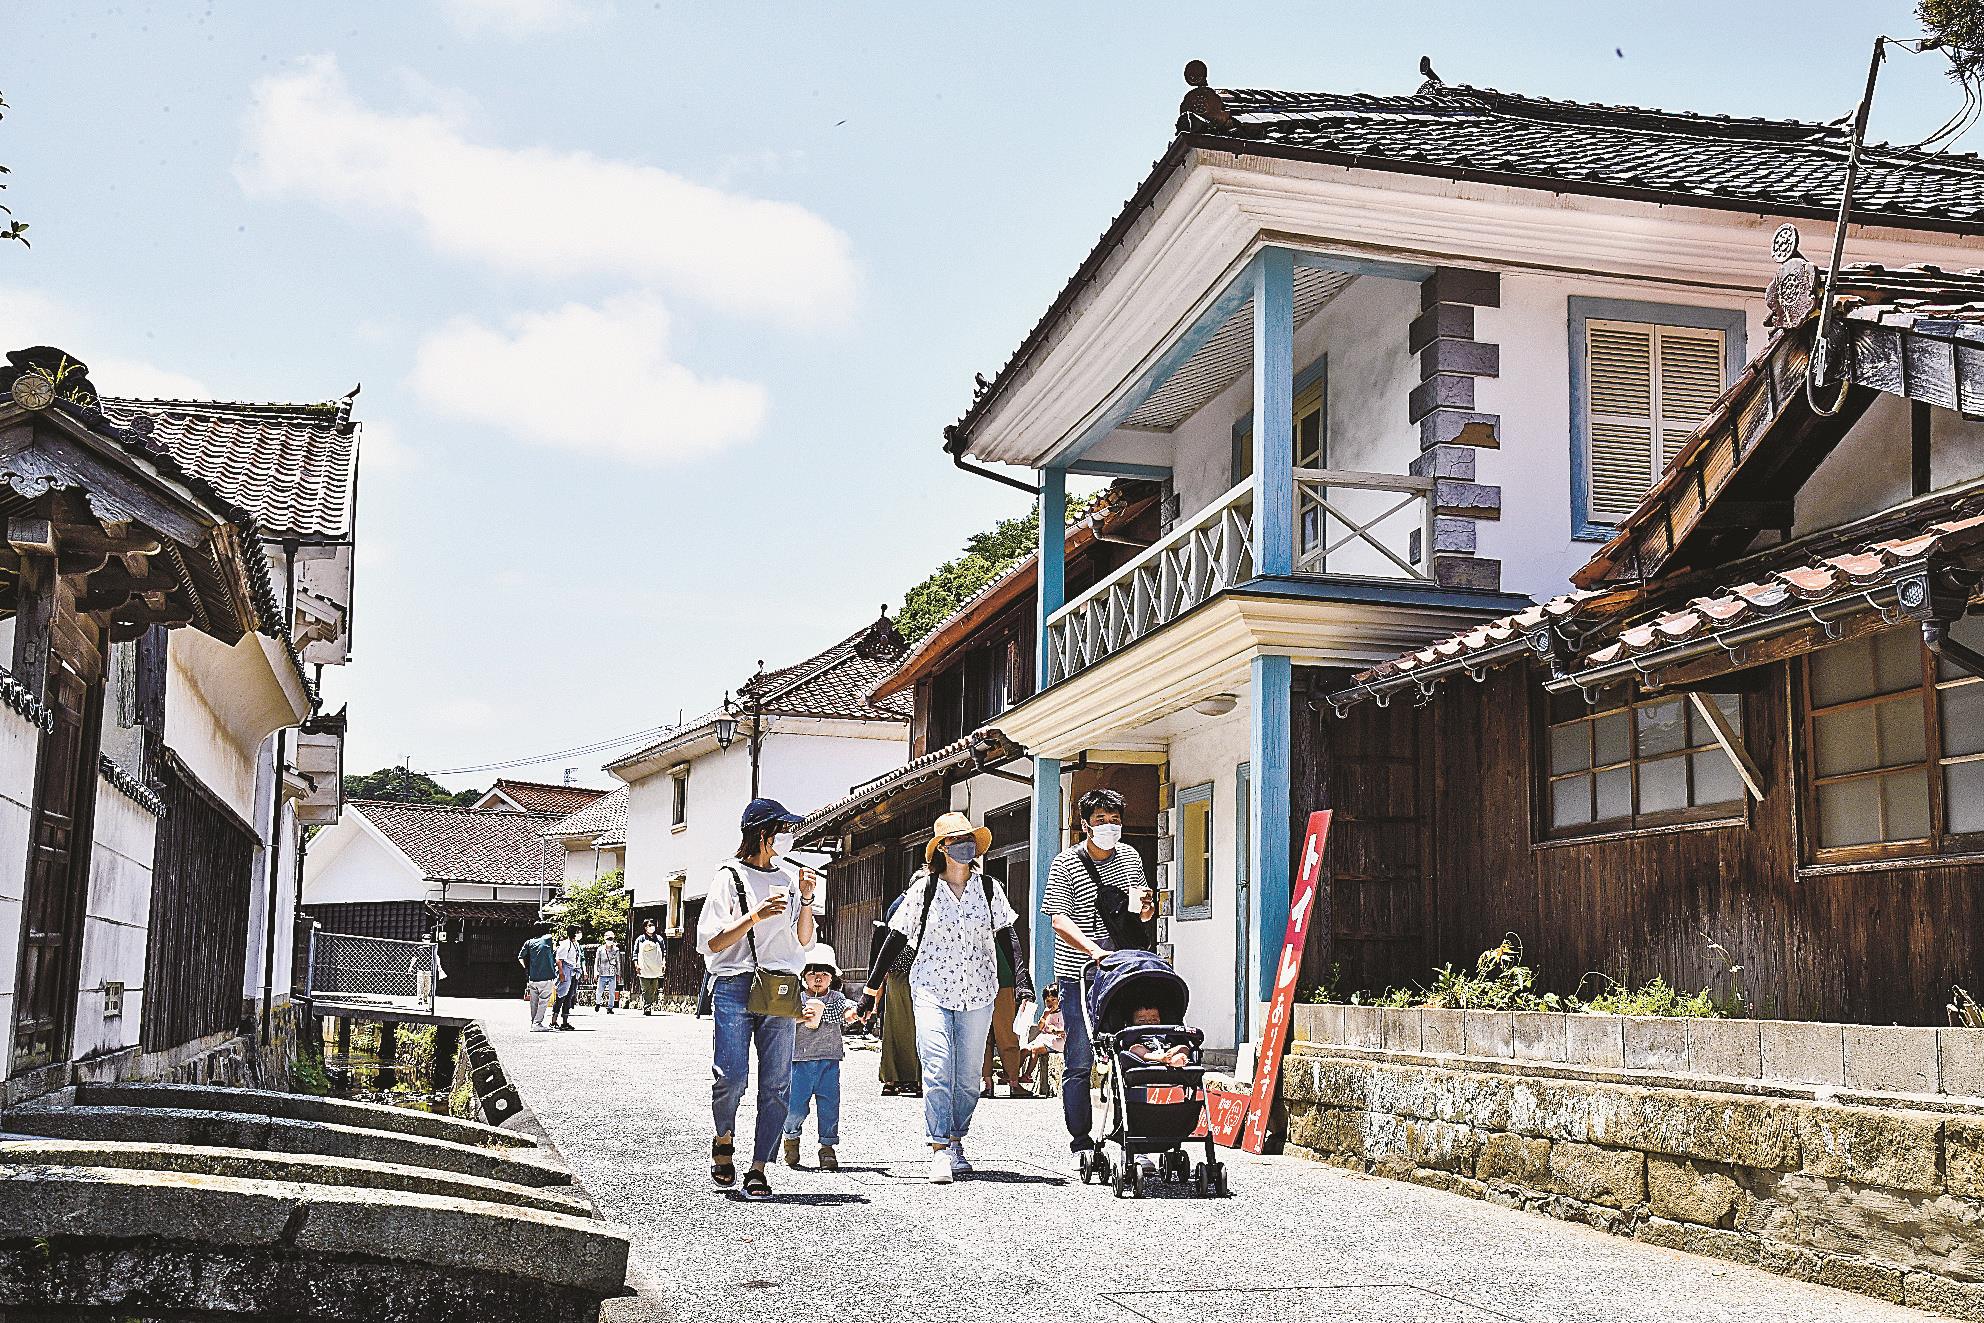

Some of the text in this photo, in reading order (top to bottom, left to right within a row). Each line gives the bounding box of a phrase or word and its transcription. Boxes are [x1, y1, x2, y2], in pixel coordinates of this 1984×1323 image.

[1278, 833, 1319, 989] トイレ
[1259, 992, 1285, 1100] あります
